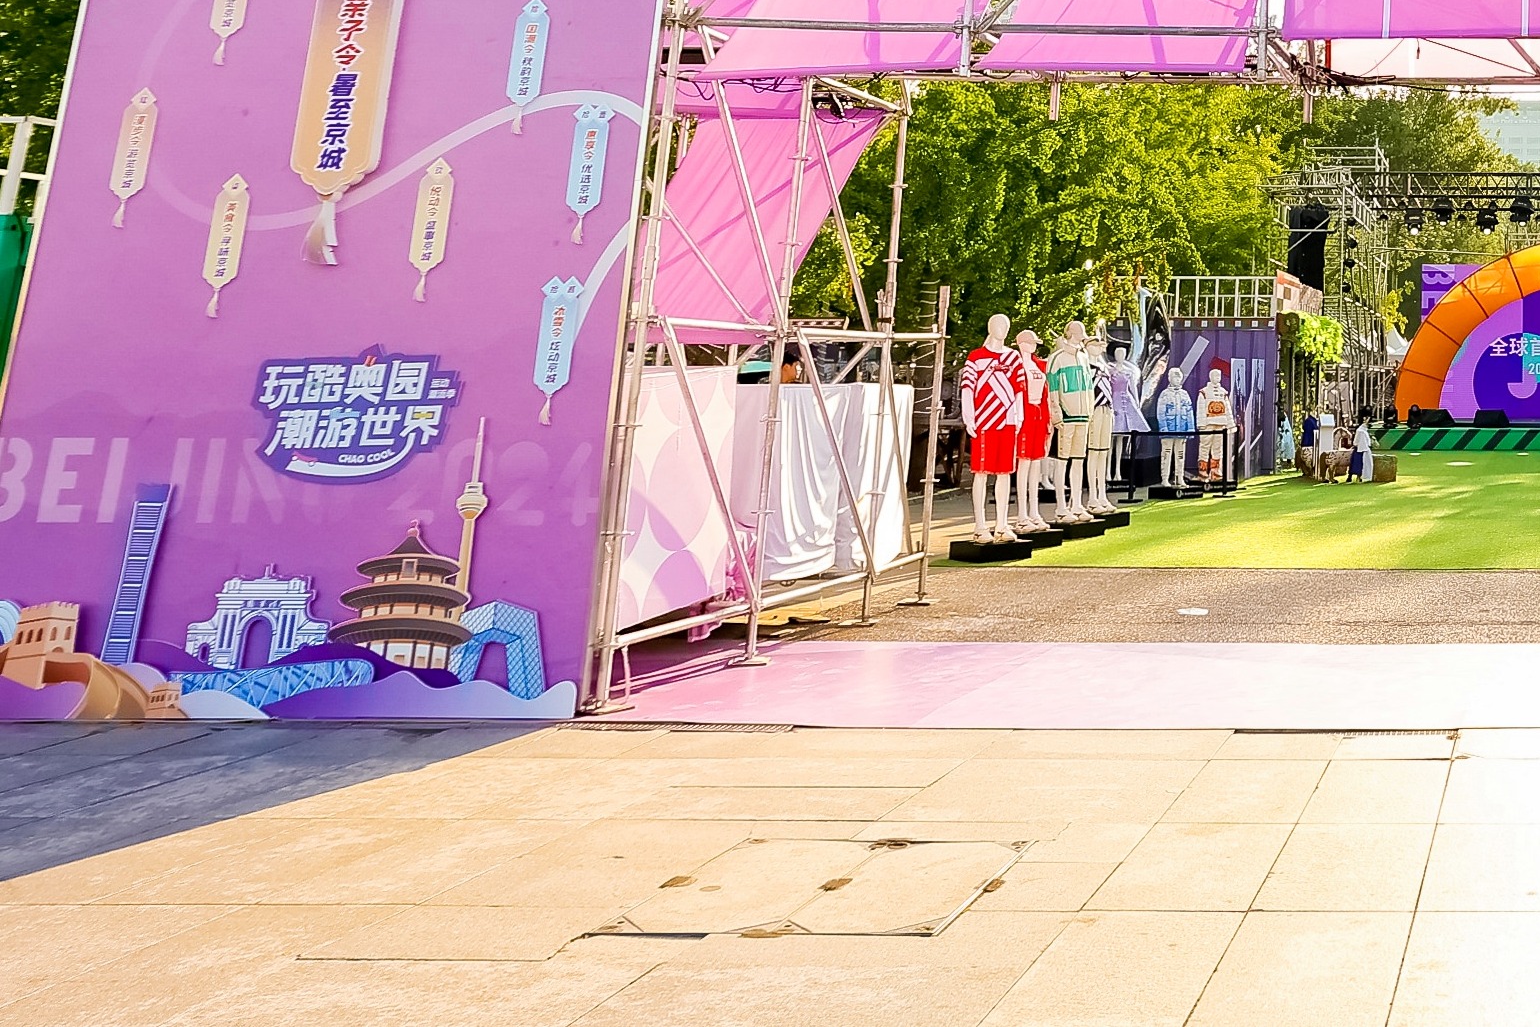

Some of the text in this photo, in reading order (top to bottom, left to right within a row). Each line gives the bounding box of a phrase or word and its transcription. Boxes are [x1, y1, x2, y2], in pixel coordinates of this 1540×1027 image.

[258, 356, 430, 411] 玩酷奥园
[264, 404, 444, 457] 潮游世界
[338, 448, 396, 464] CHAO COOL
